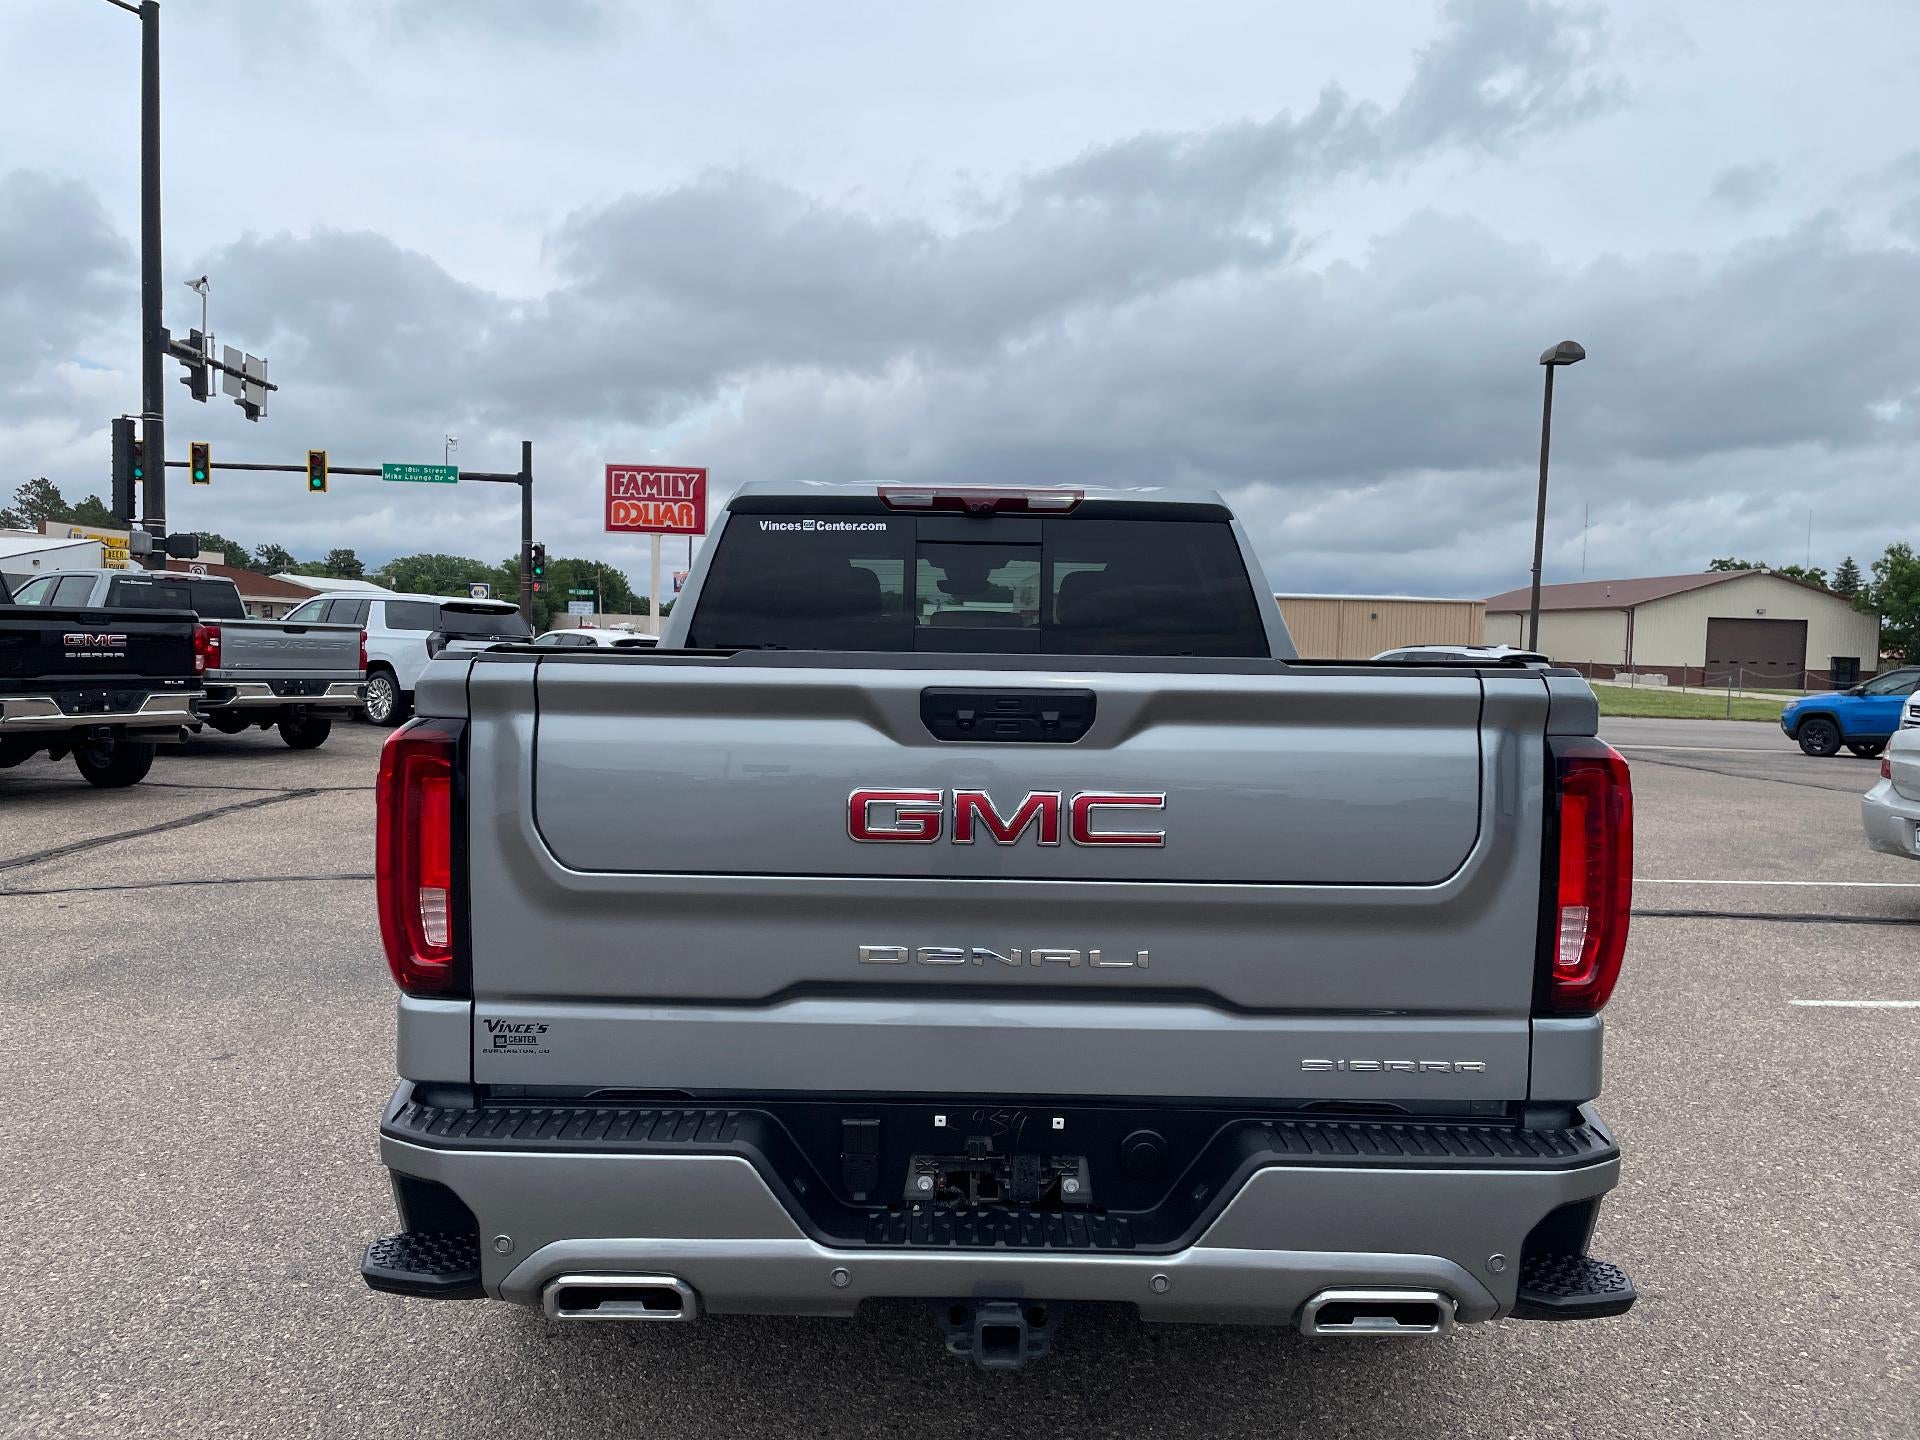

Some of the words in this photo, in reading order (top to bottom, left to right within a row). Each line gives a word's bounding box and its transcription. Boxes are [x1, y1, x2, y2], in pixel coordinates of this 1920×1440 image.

[611, 471, 700, 499] FAMILY
[611, 500, 696, 528] DOLLAR
[759, 521, 801, 531] Vinces
[816, 521, 887, 531] Center.com
[63, 633, 127, 647] GMC
[231, 639, 353, 650] CHEVROLET
[847, 787, 1166, 848] GMC
[859, 945, 1150, 969] DENALI
[508, 1035, 537, 1044] CENTER
[1301, 1059, 1486, 1073] SIERRA
